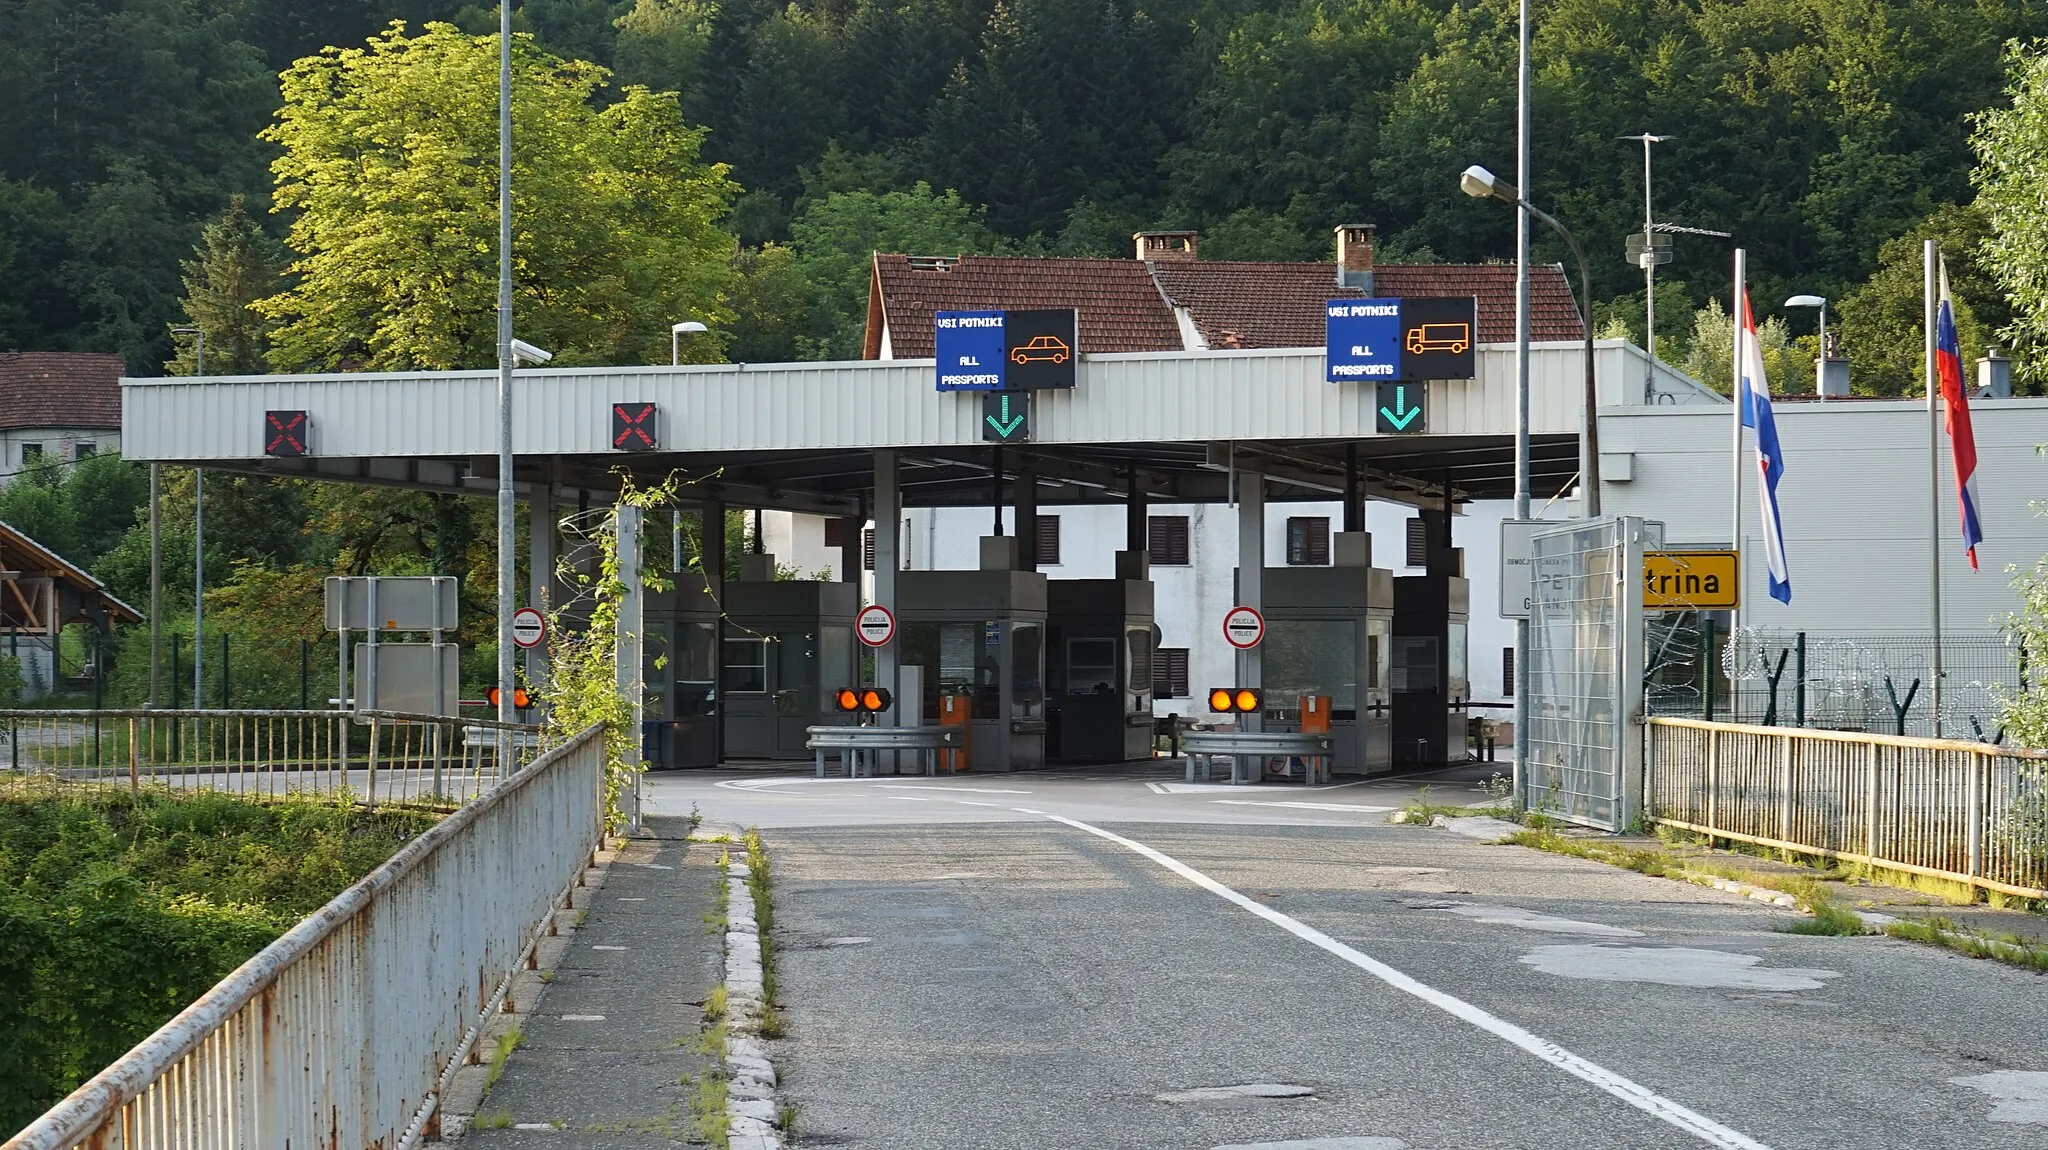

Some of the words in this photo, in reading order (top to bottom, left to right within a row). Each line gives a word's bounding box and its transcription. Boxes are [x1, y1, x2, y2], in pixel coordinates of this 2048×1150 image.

[1328, 307, 1349, 317] VSI
[1351, 305, 1398, 316] POTNIKI
[937, 319, 957, 328] VSI
[959, 317, 1003, 328] POTNIKI
[1351, 345, 1374, 356] ALL
[959, 356, 980, 366] ALL
[1332, 364, 1394, 375] PASSPORTS
[941, 374, 999, 385] PASSPORTS
[1645, 568, 1719, 594] trina
